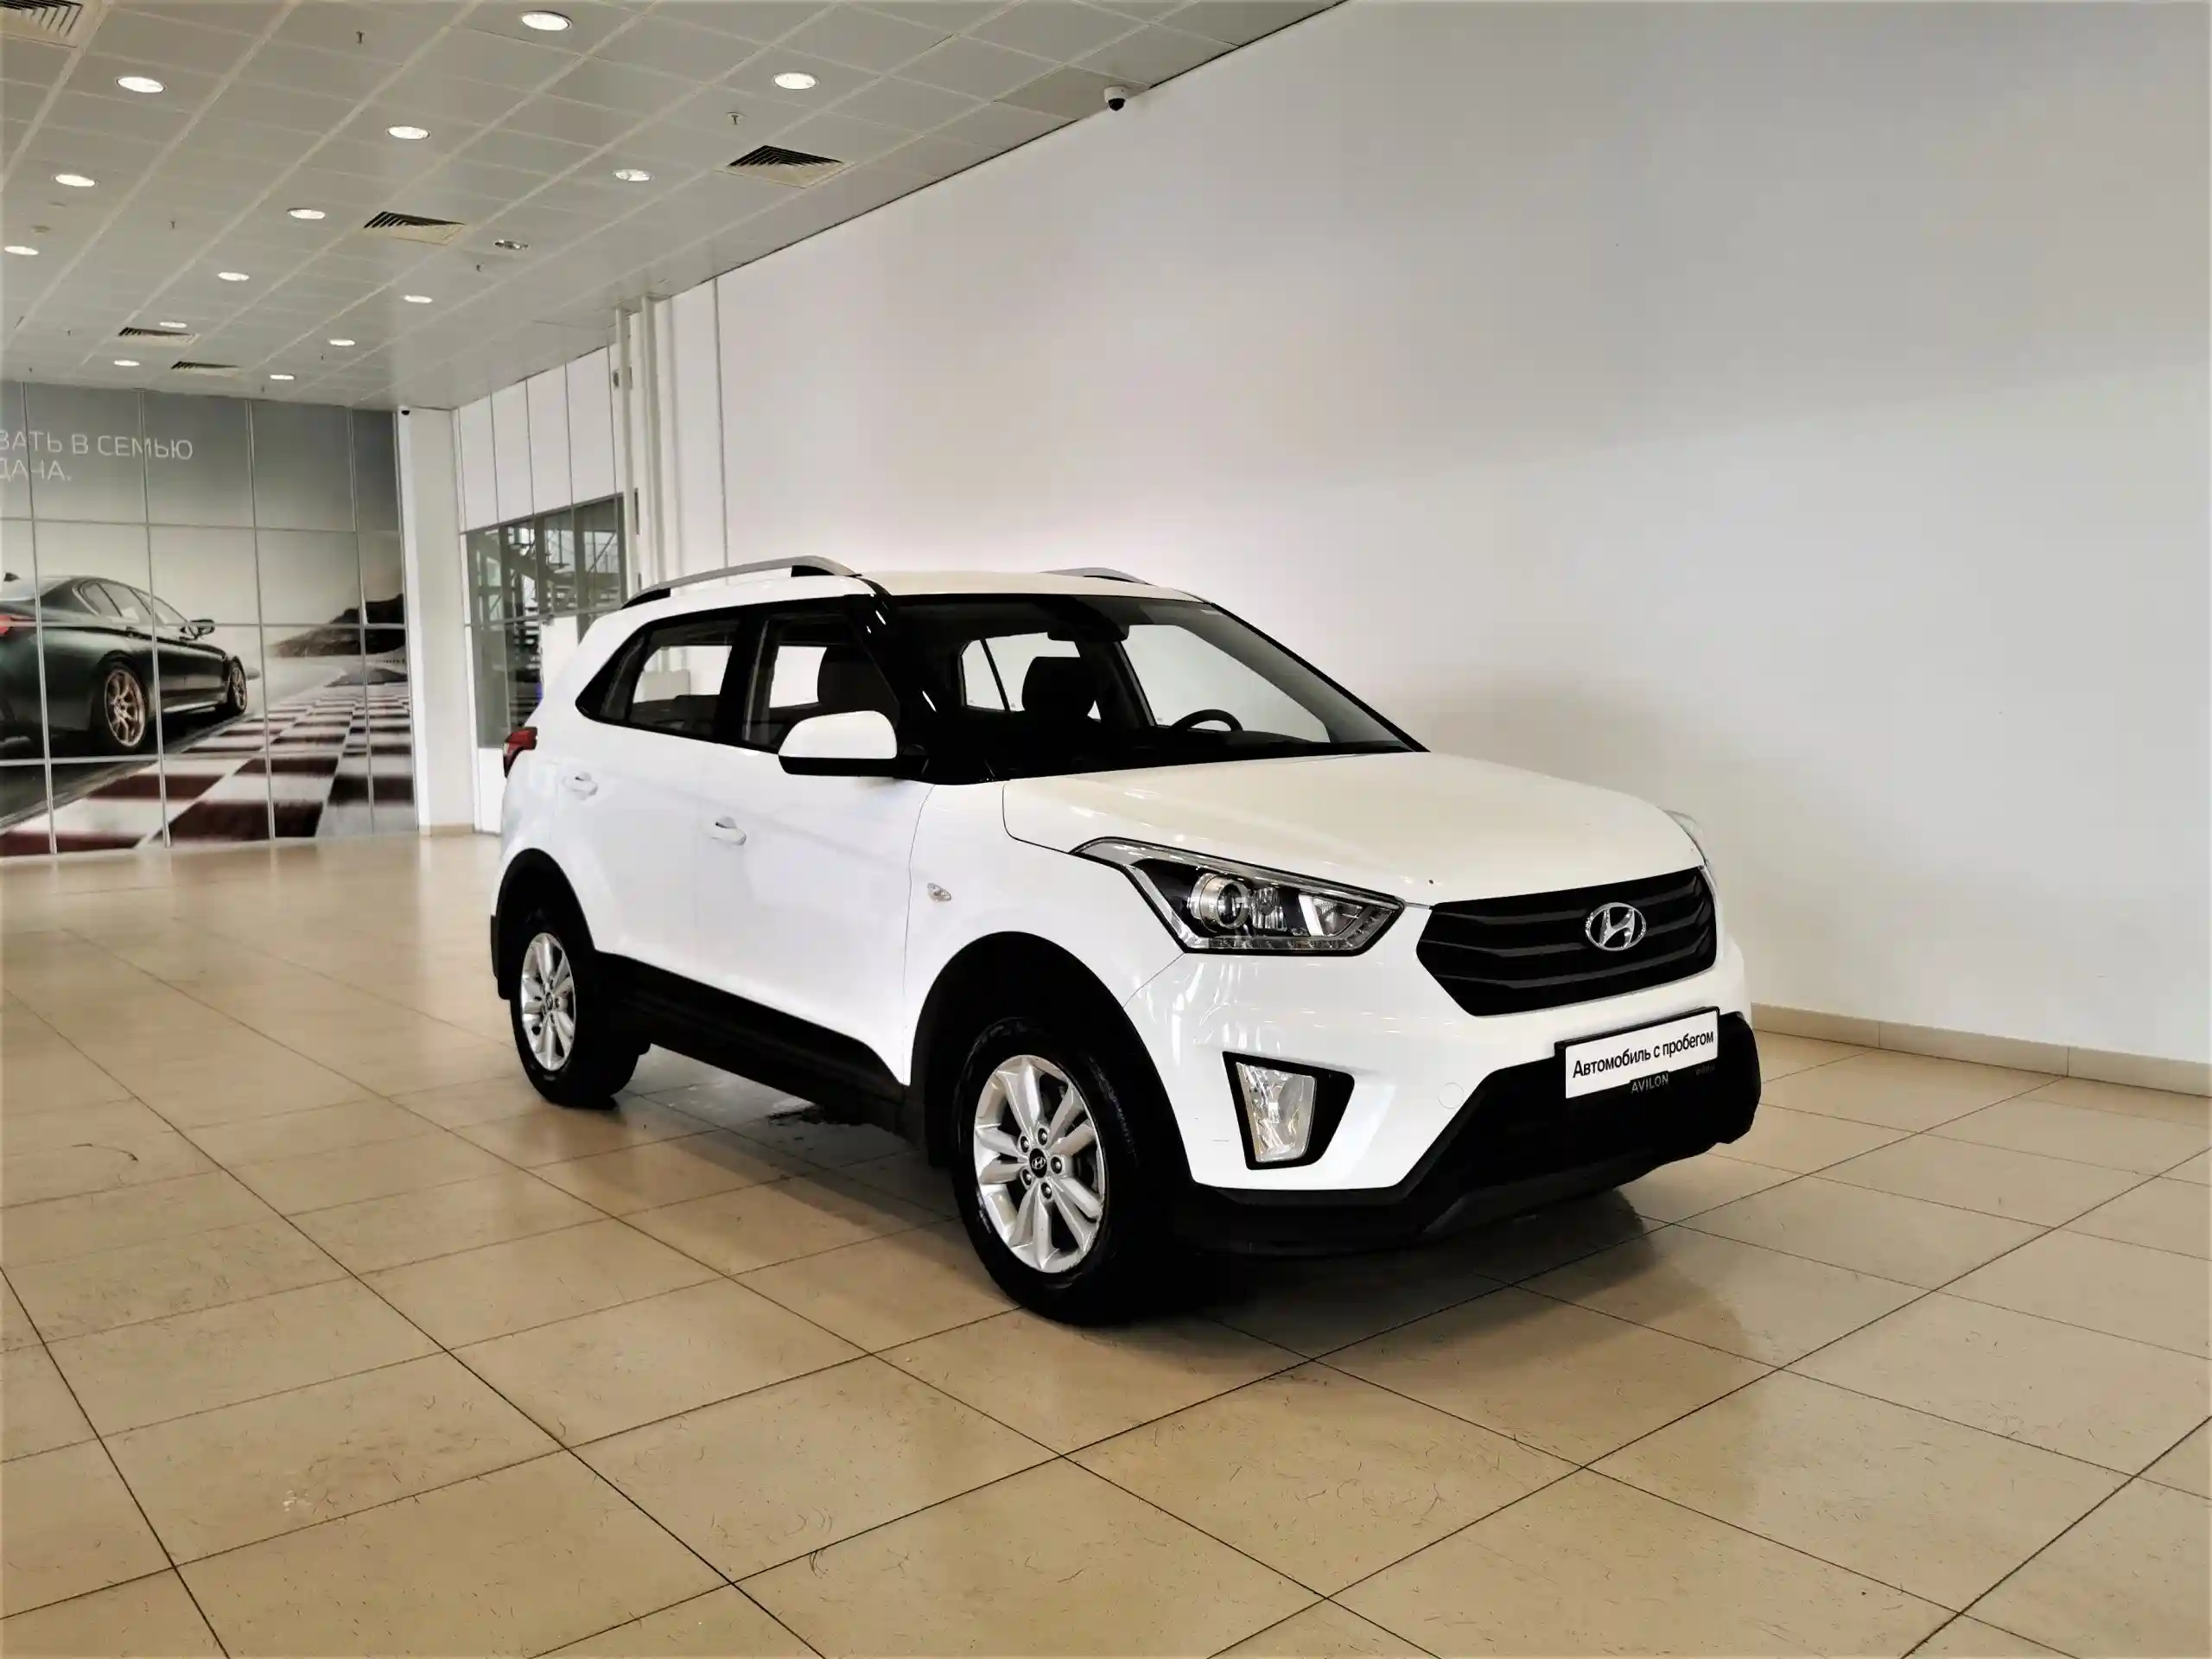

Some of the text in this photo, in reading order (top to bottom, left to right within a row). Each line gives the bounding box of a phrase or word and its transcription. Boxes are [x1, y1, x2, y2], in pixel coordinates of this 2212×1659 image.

[72, 434, 89, 455] В
[98, 435, 194, 460] СЕМЬЮ
[1573, 1031, 1714, 1077] Автомобиль с пробегом
[1630, 1074, 1669, 1093] AVILON
